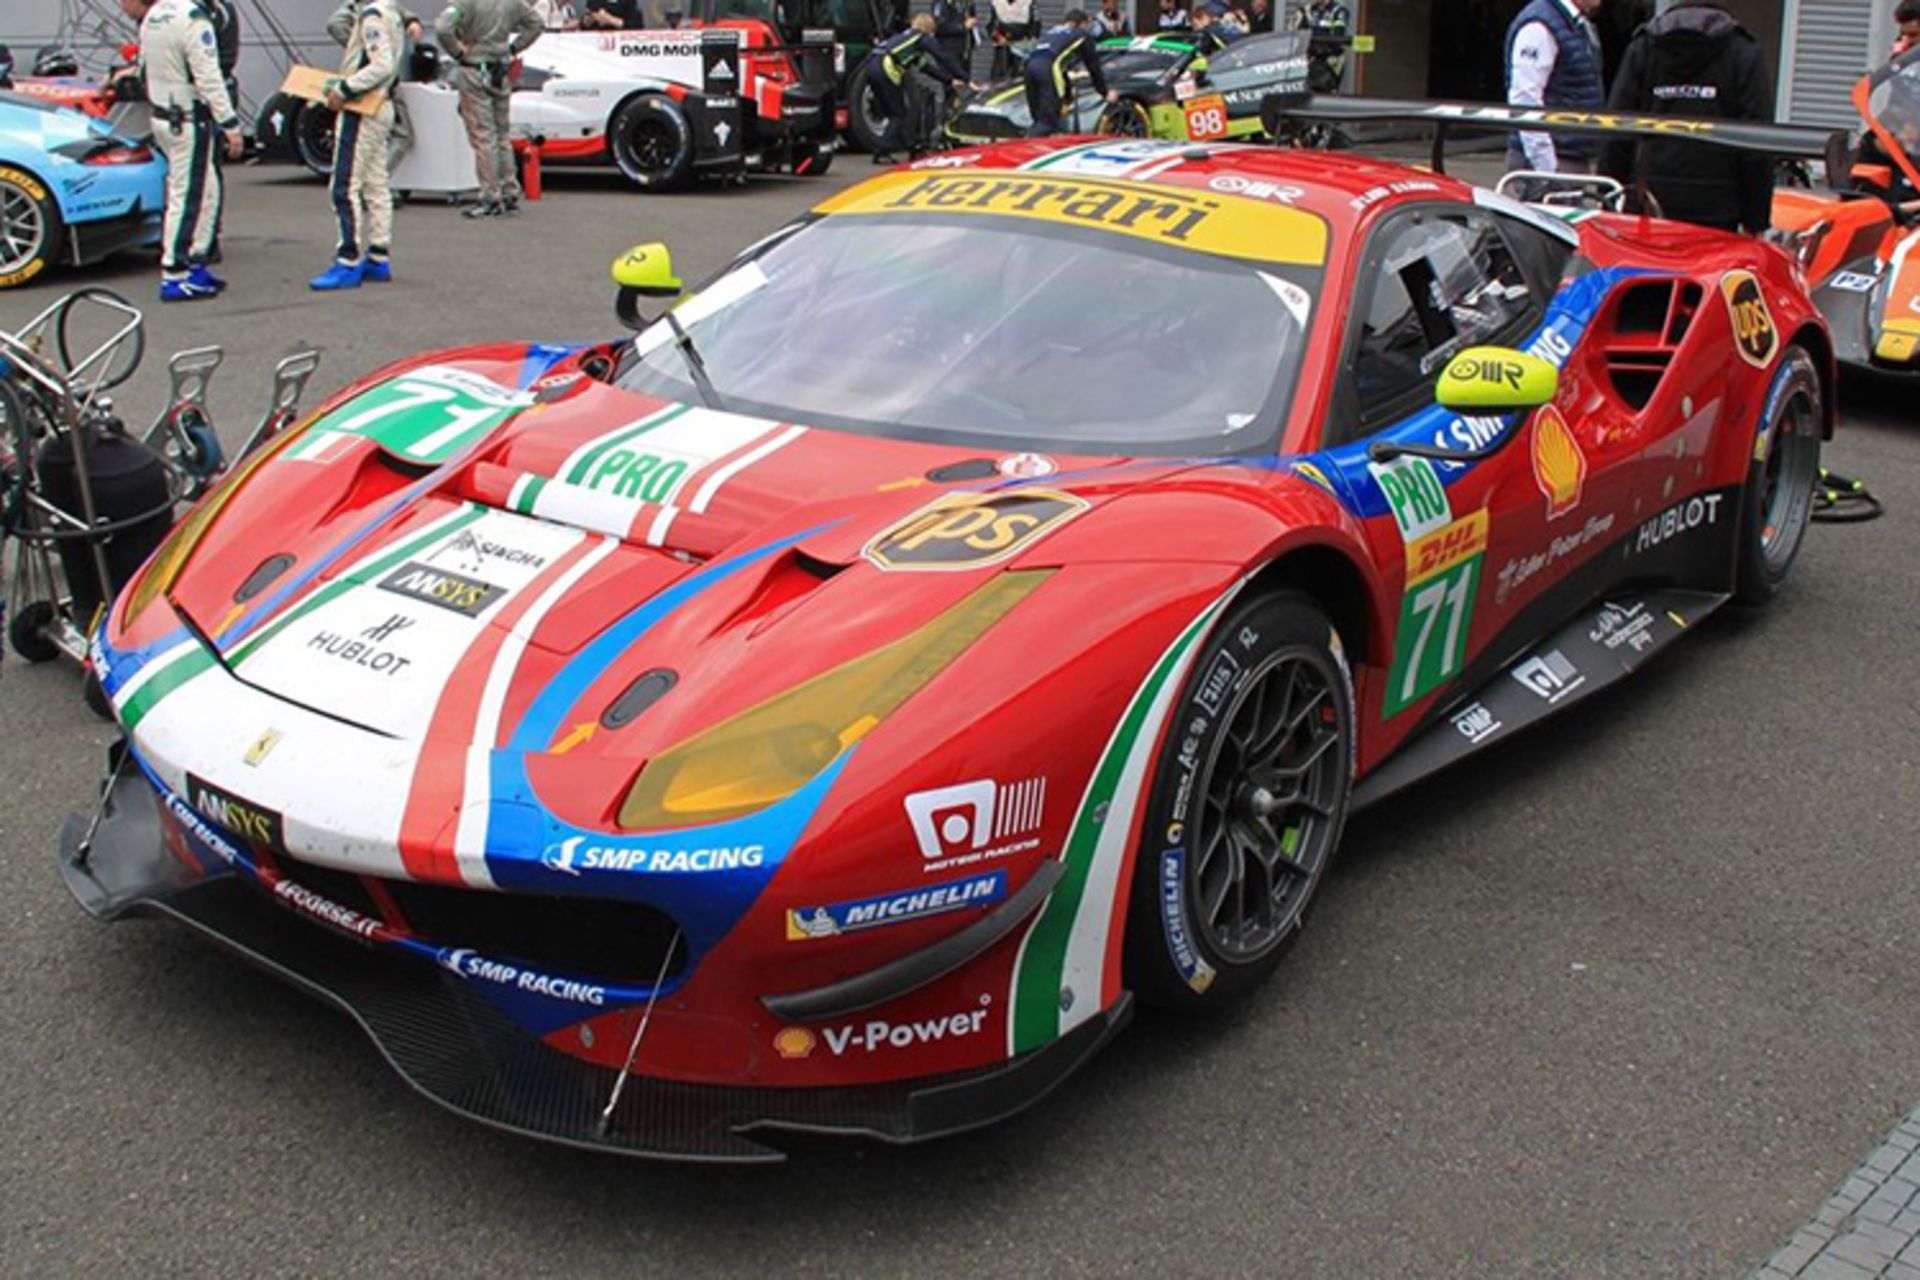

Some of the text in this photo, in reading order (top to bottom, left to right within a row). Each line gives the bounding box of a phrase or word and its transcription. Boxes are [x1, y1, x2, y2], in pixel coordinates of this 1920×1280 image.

[621, 44, 703, 56] DMG MOR
[1189, 108, 1223, 136] 98
[885, 175, 1220, 241] Ferrari
[1733, 300, 1770, 351] ups
[294, 379, 499, 461] 71
[588, 448, 689, 504] PRO
[1379, 458, 1446, 532] PRO
[1417, 520, 1478, 574] DHL
[1636, 494, 1723, 552] HUBLOT
[394, 570, 487, 607] ANSYS
[308, 630, 412, 677] HUBLOT
[1401, 561, 1474, 702] 71
[197, 788, 272, 845] ANSYS
[581, 845, 763, 872] SMP RACING
[844, 877, 996, 924] MICHELIN
[1164, 857, 1192, 969] MICHELIN
[467, 956, 605, 1006] SMP RACING
[823, 1008, 988, 1056] V-Power
